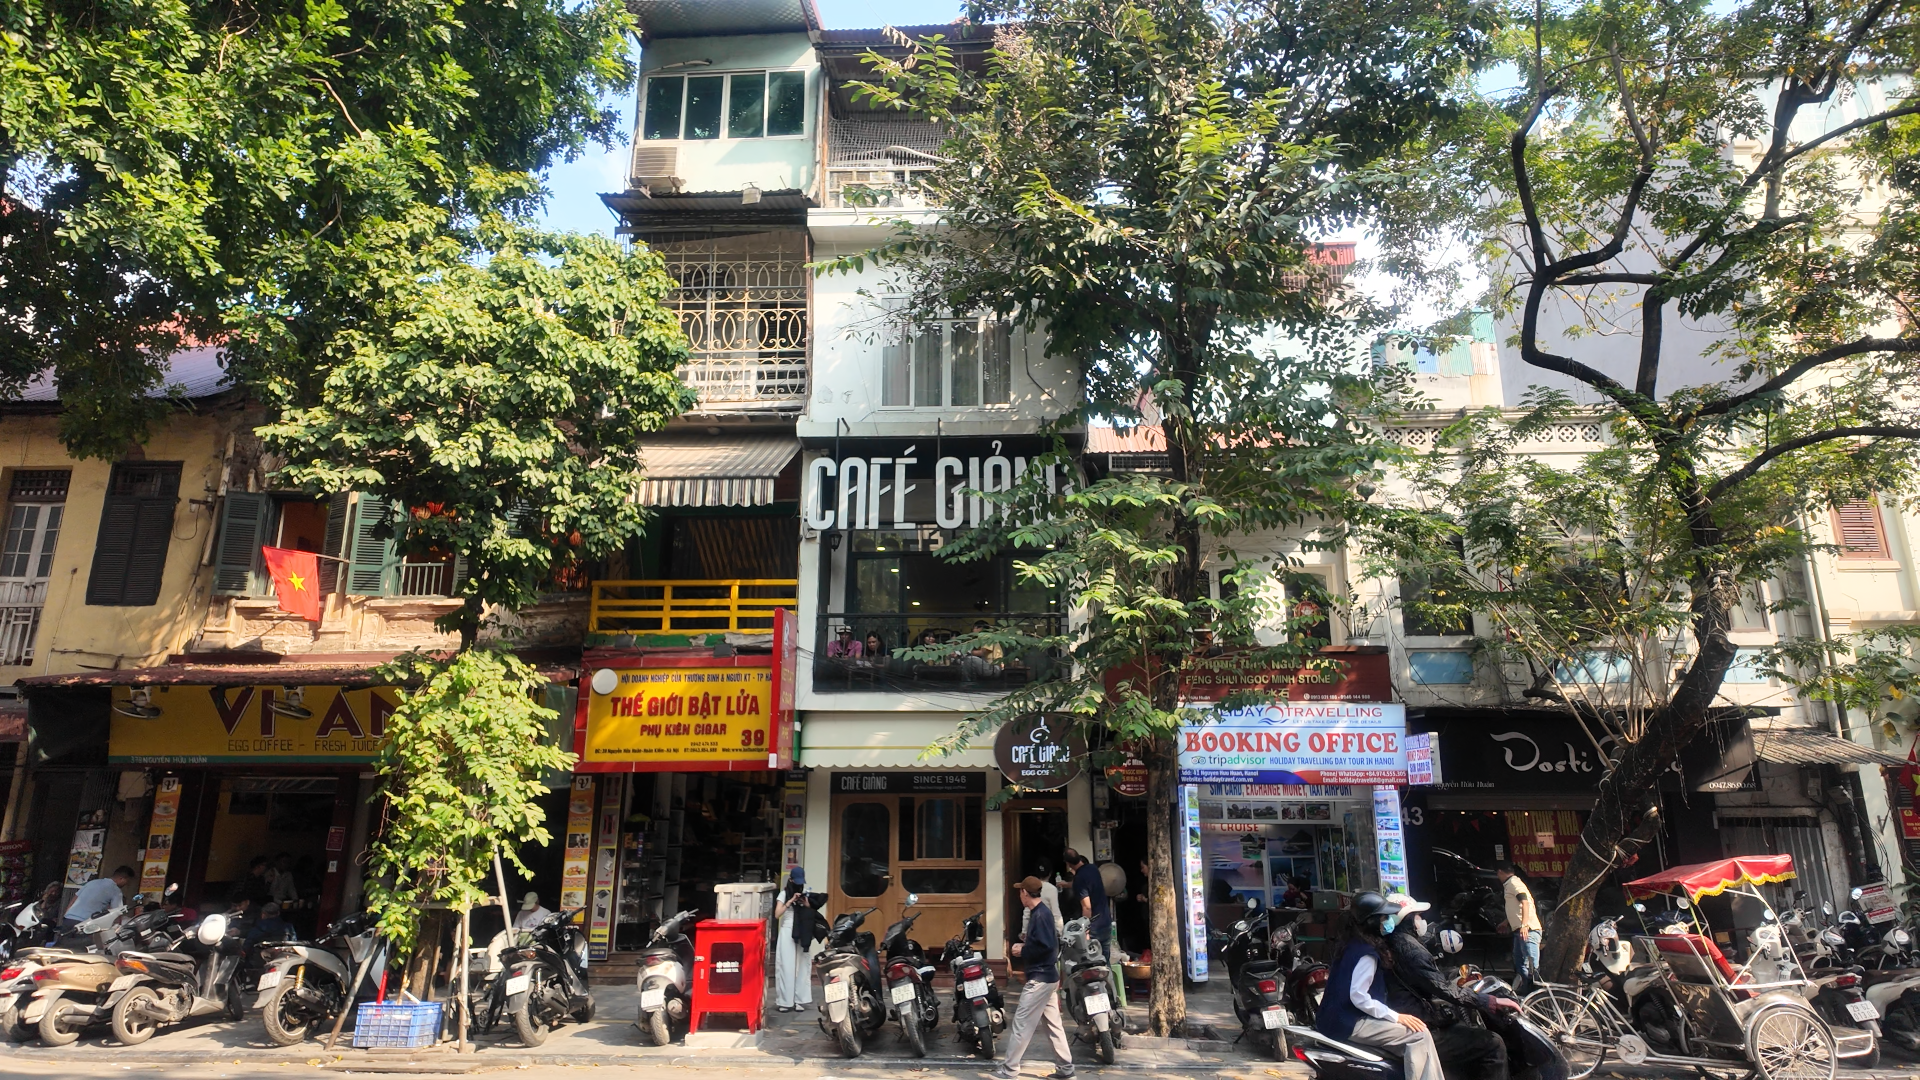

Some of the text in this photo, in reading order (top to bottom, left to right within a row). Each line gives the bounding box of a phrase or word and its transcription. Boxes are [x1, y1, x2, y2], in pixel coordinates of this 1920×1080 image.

[807, 444, 918, 530] CAFÉ
[1186, 674, 1330, 684] FENG SHUI NGOC MINH STONE
[610, 688, 760, 719] THẾ GIỚI BẬT LỬA
[208, 690, 276, 738] VI
[1285, 708, 1382, 718] TRAVELLING
[640, 724, 662, 738] PHỤ
[694, 724, 727, 736] CIGAR
[741, 730, 764, 746] 39
[228, 740, 249, 751] EGG
[253, 740, 293, 751] COFFEE
[315, 740, 346, 751] FRESH
[1185, 732, 1398, 753] BOOKING OFFICE
[1490, 732, 1593, 773] Dosti
[1208, 754, 1266, 766] tripadvisor
[841, 773, 887, 790] CAFÉ GIẢNG
[913, 776, 942, 784] SINCE
[1246, 784, 1280, 796] EXCHANGE
[1324, 785, 1352, 796] AIRPORT
[1402, 807, 1424, 826] 43
[1221, 824, 1259, 832] CRUISE
[1529, 862, 1548, 872] 0961
